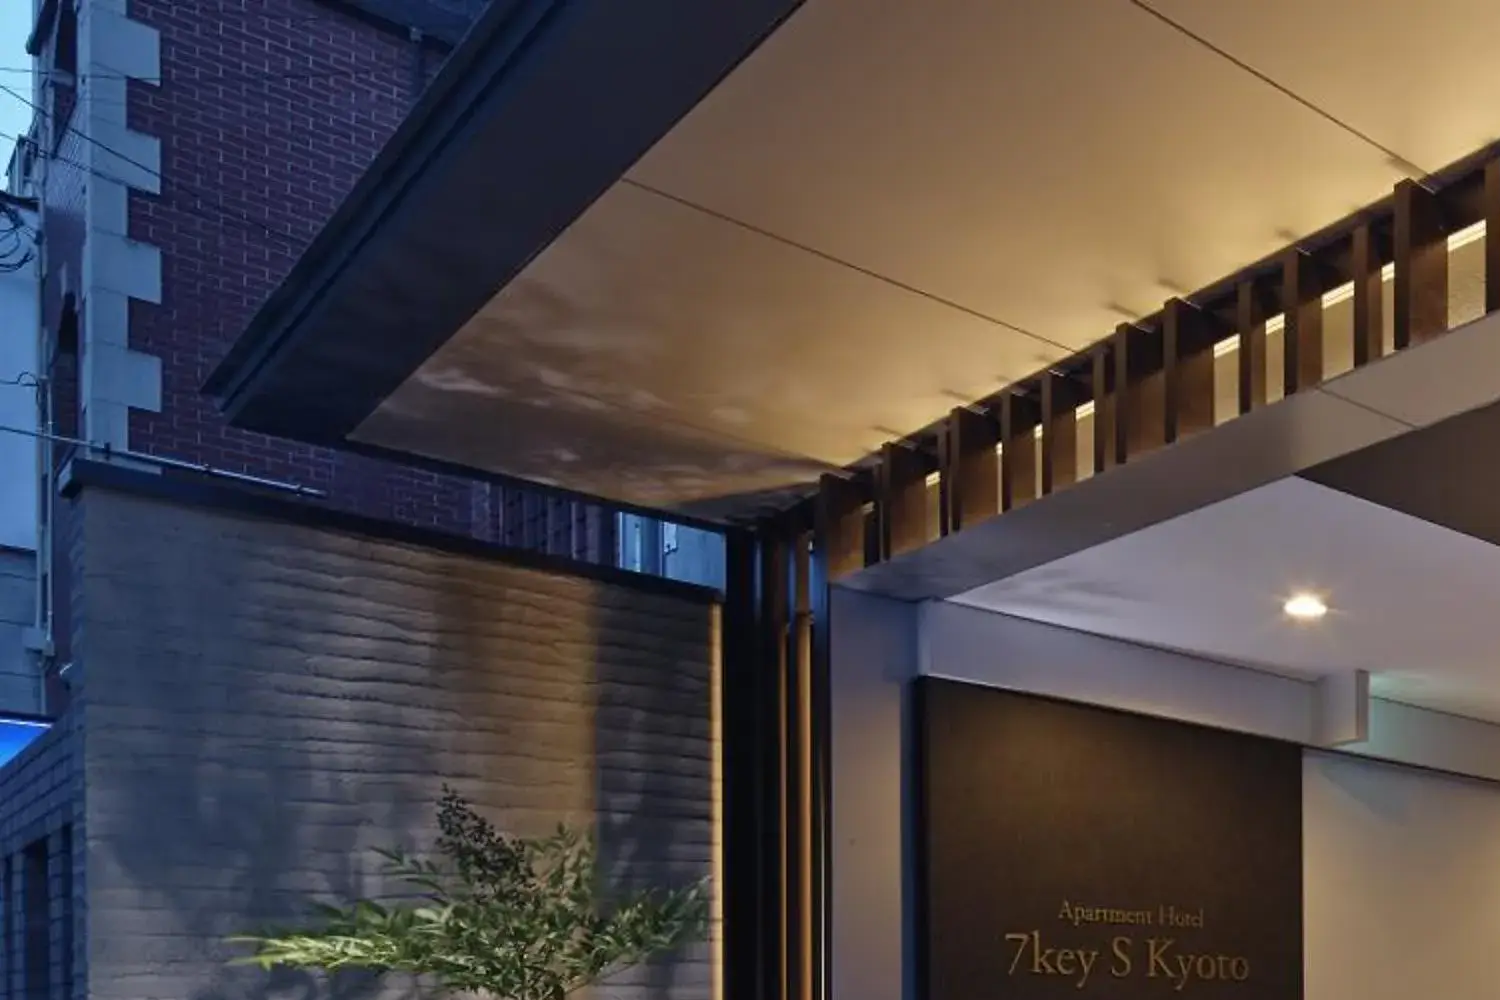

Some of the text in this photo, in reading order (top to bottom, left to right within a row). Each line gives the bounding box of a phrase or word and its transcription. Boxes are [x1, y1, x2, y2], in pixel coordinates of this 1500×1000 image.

[1057, 900, 1204, 928] Apartment Hotel
[1005, 930, 1250, 990] 7key S Kyoto
